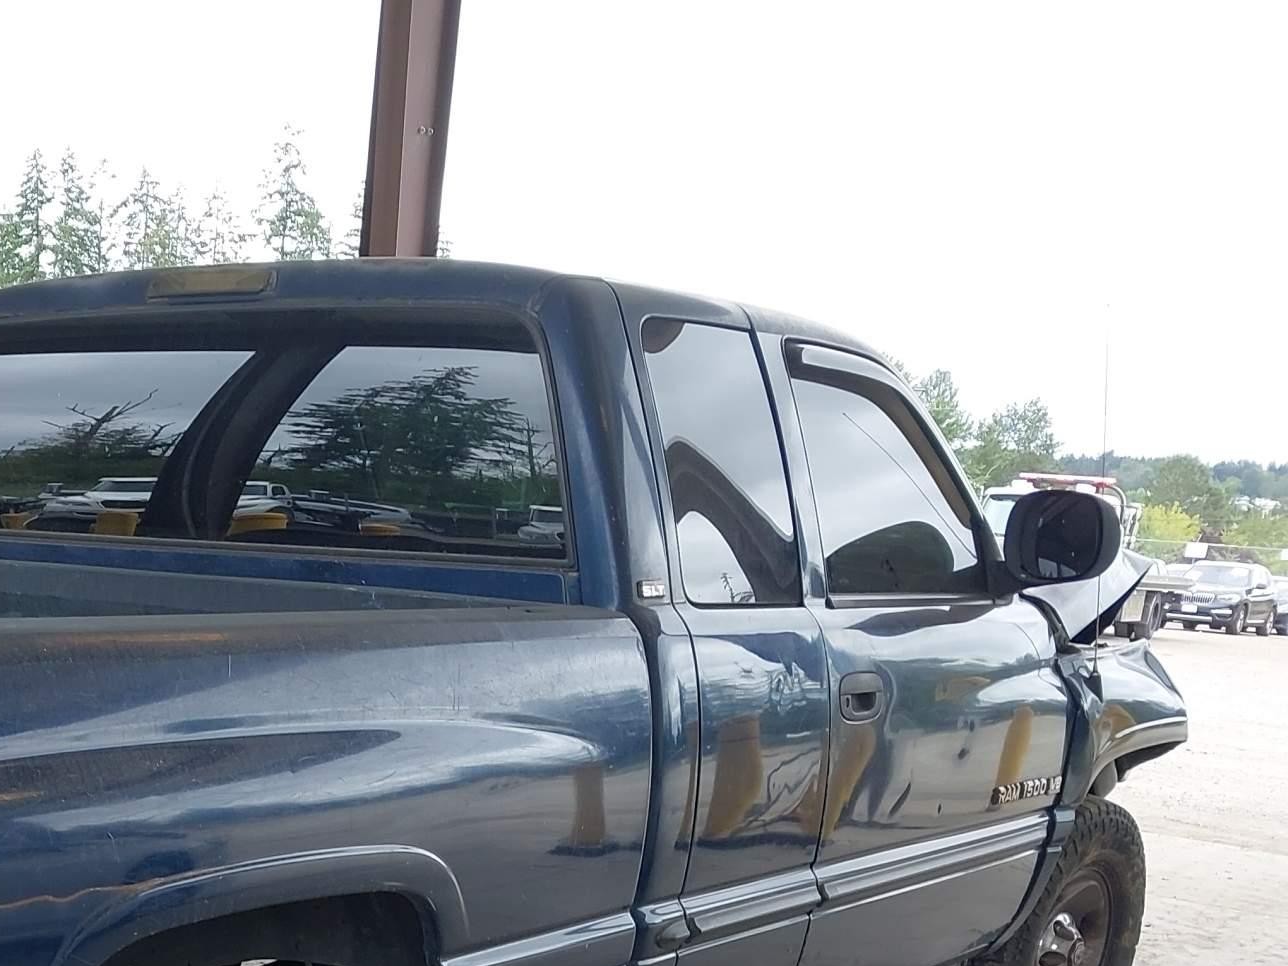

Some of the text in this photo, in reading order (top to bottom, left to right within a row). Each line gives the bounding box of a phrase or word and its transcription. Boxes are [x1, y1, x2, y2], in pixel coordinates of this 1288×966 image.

[642, 584, 665, 597] SLT
[998, 782, 1021, 805] RAM
[1023, 778, 1047, 798] 1500
